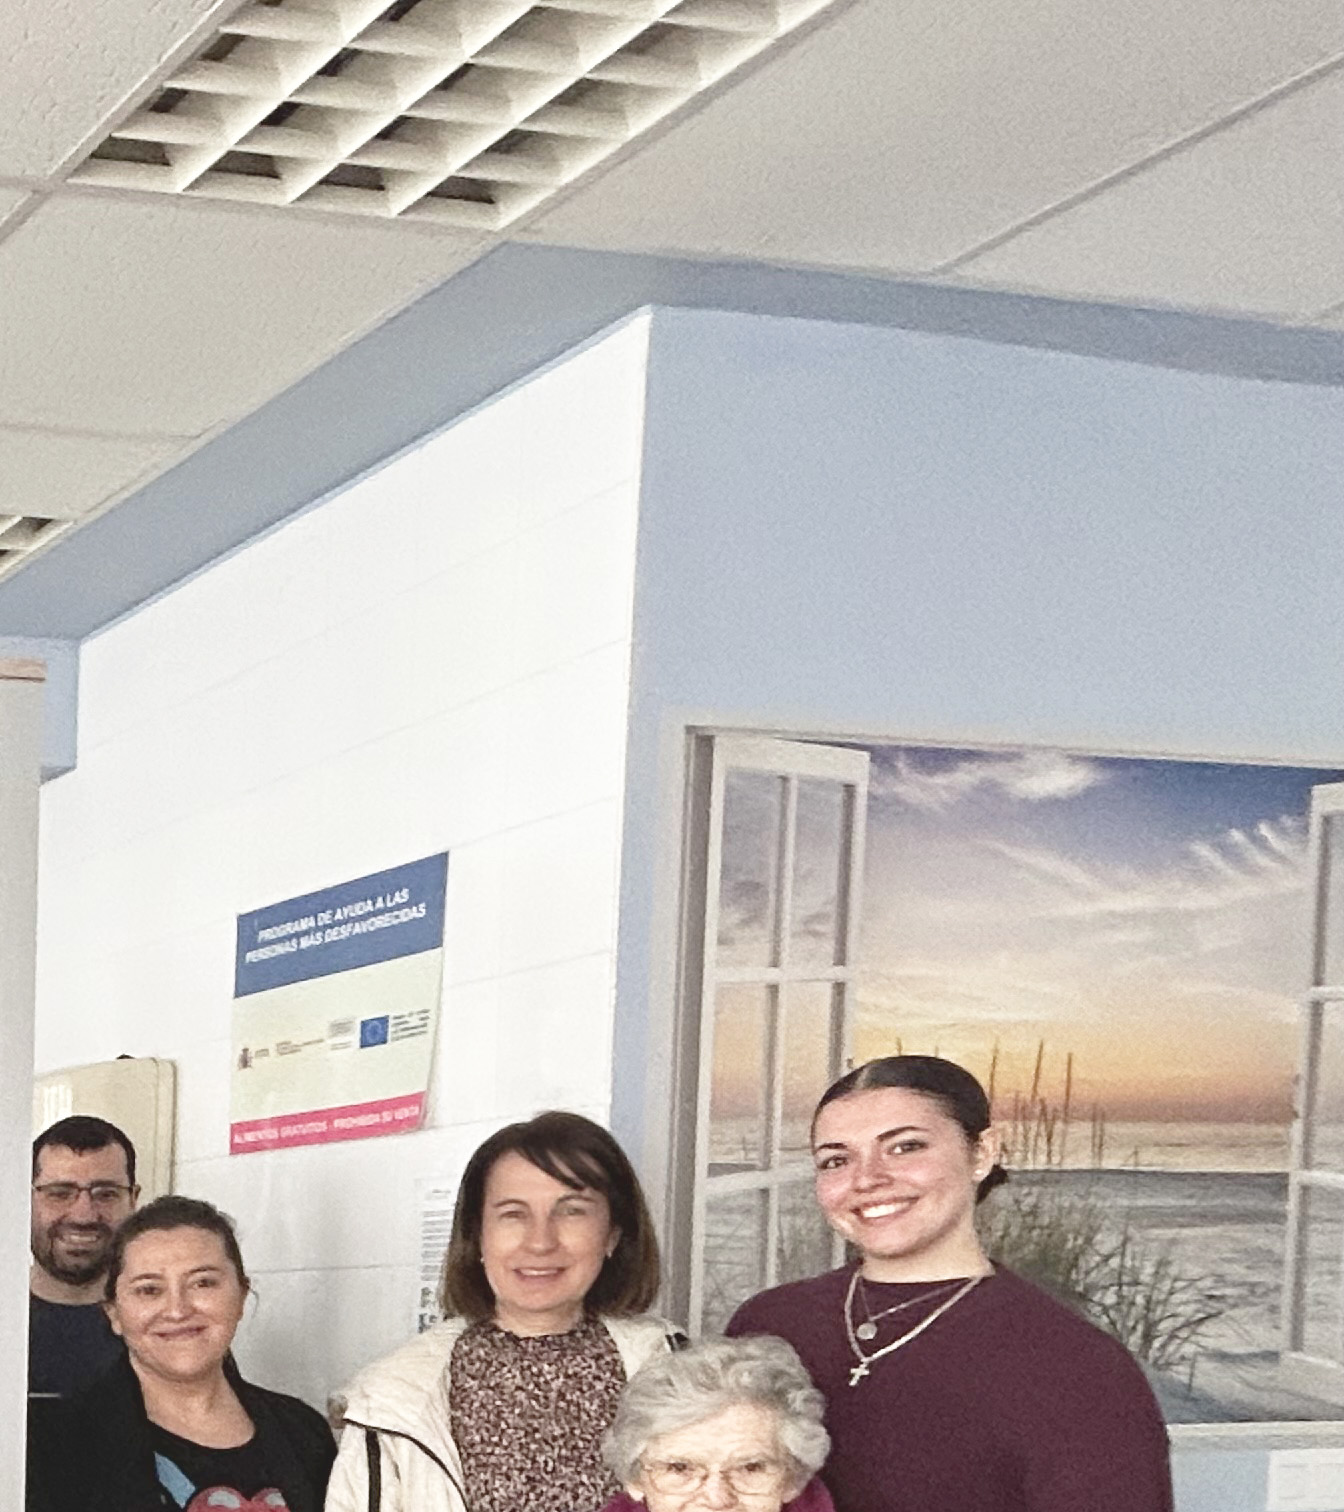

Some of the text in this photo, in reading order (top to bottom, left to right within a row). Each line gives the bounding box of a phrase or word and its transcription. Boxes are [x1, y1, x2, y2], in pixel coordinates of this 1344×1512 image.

[245, 902, 427, 964] PERSONAS MÁS DESFAVORECIDAS
[258, 888, 410, 943] PROGRAMA DE AYUDA A LAS
